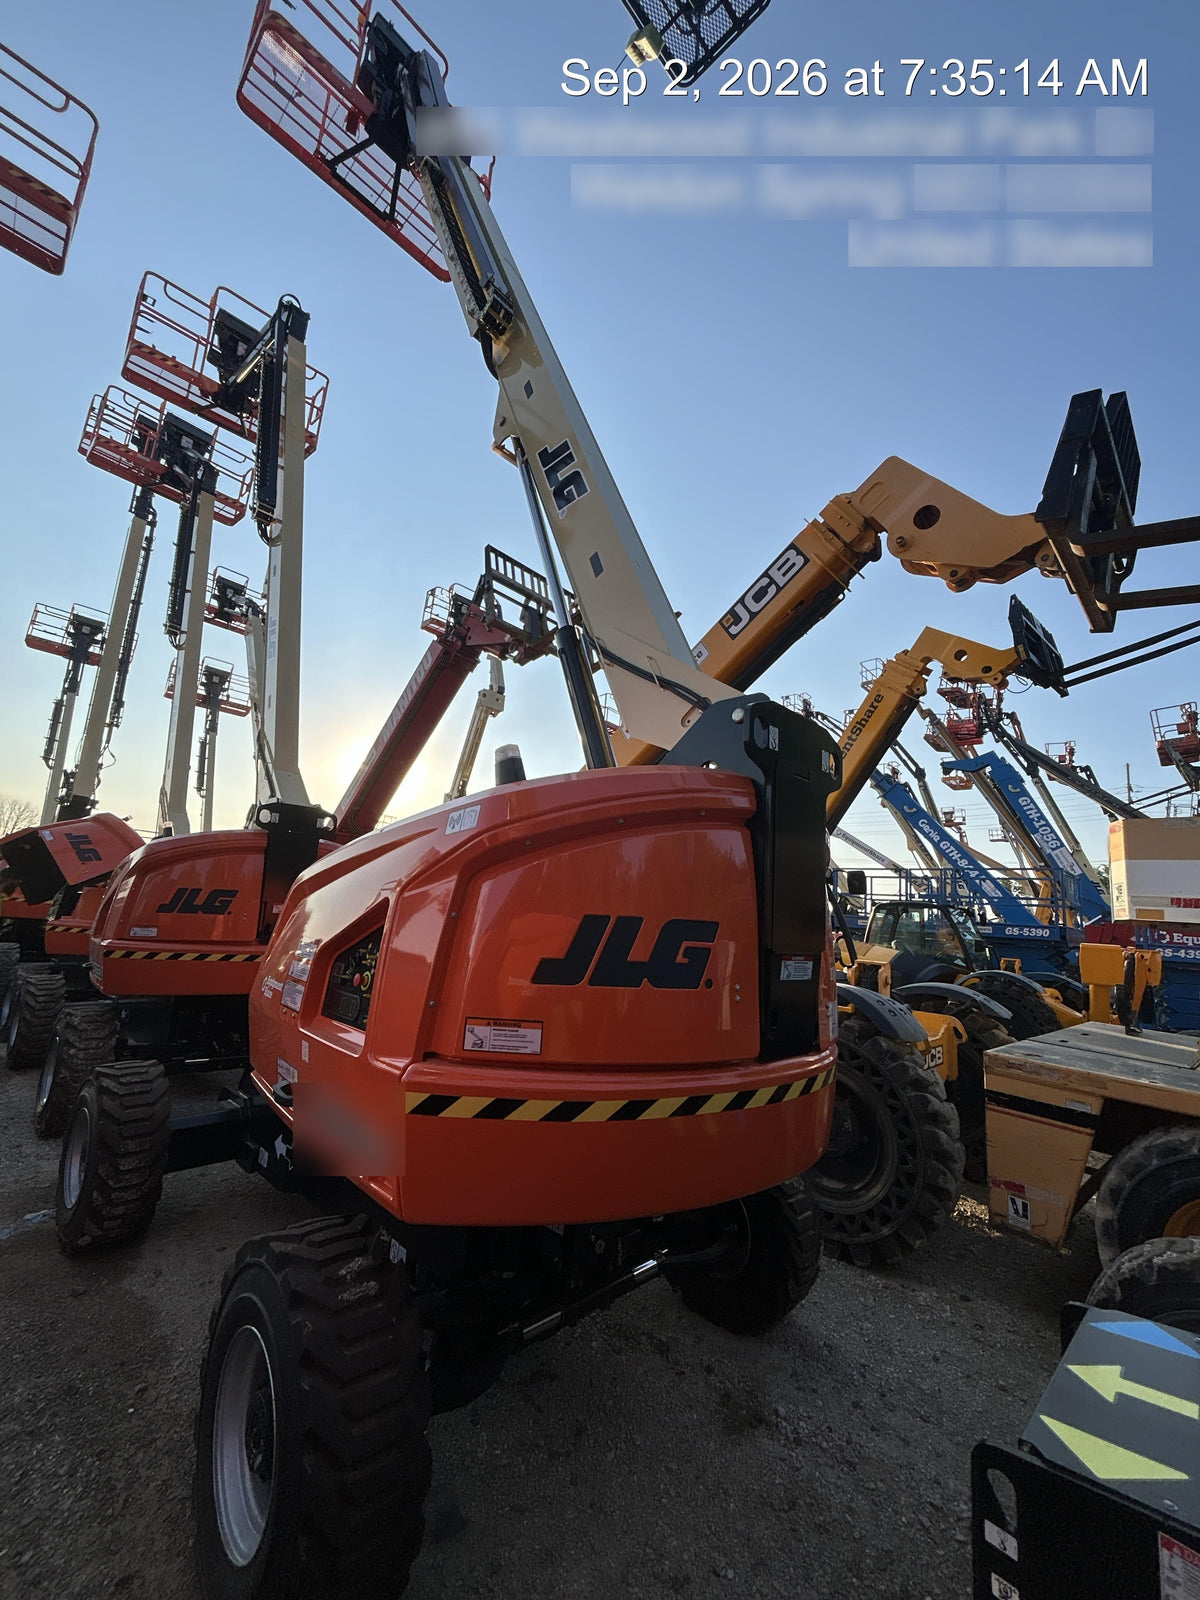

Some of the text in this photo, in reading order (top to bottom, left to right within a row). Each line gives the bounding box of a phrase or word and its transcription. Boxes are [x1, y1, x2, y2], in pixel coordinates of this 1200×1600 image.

[536, 438, 590, 512] JLG
[728, 548, 805, 635] JCB
[381, 650, 433, 742] MANITOU
[918, 818, 941, 843] Genie
[1018, 797, 1060, 849] GTH-1056
[64, 832, 103, 862] JLG
[841, 831, 886, 863] EquipmentShare
[156, 887, 239, 915] JLG
[1005, 926, 1050, 938] GS-5390
[531, 914, 719, 989] JLG
[923, 1046, 943, 1070] JCB
